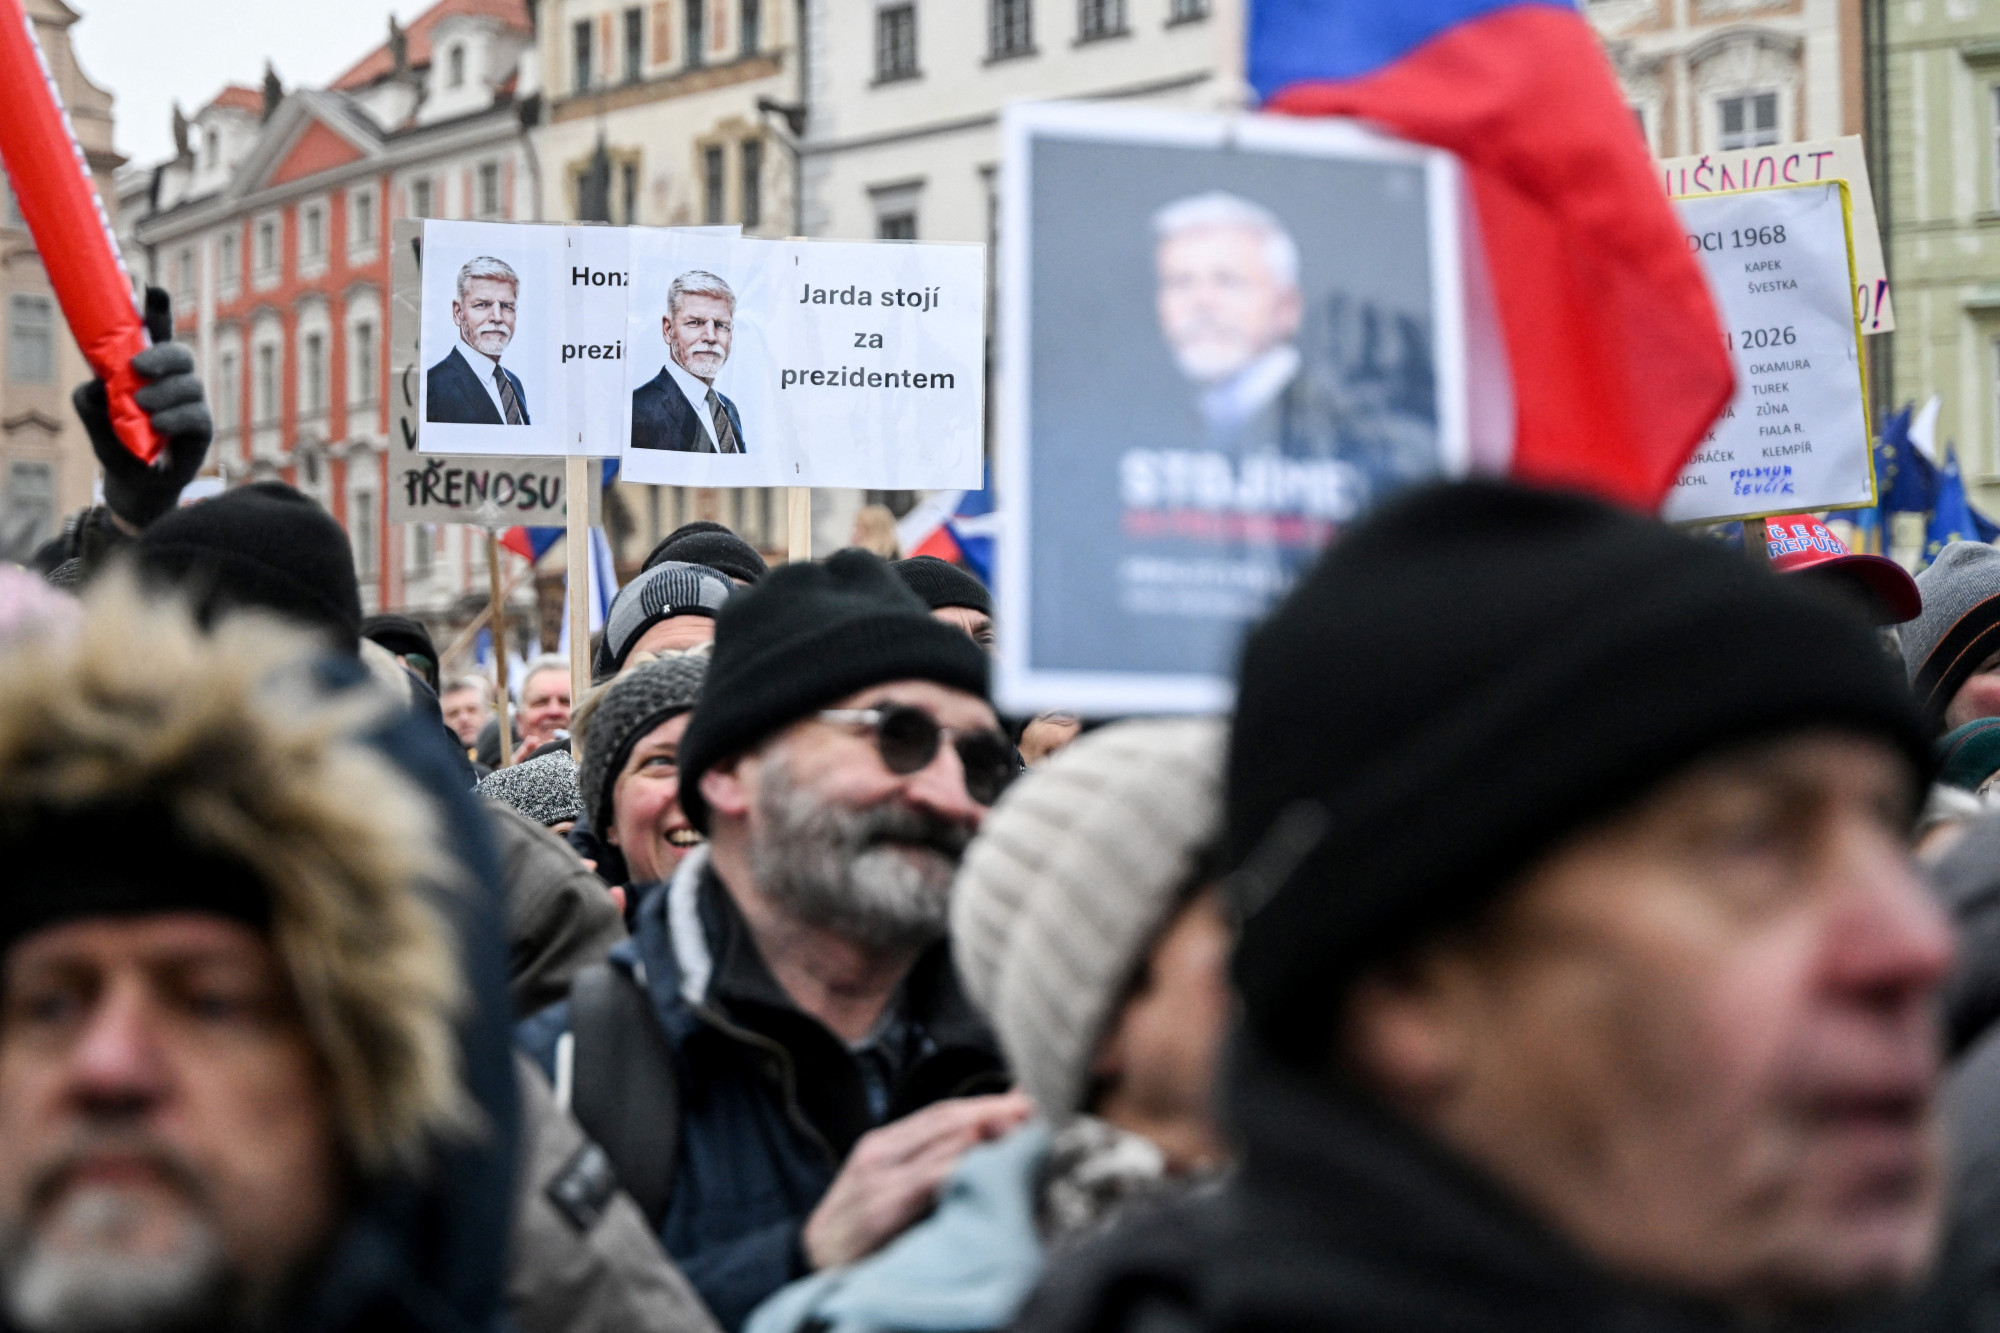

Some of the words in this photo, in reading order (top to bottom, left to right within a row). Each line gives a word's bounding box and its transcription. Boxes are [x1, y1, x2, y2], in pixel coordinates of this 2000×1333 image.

[1666, 150, 1834, 196] UŠNOST
[1686, 231, 1723, 253] DCI
[1731, 224, 1787, 249] 1968
[1745, 259, 1782, 273] KAPEK
[1748, 279, 1798, 294] ŠVESTKA
[800, 283, 872, 307] Jarda
[881, 286, 941, 312] stojí
[854, 331, 884, 350] za
[1741, 325, 1796, 349] 2026
[562, 339, 626, 364] prezi
[1750, 359, 1811, 375] OKAMURA
[781, 366, 955, 390] prezidentem
[1752, 382, 1790, 395] TUREK
[1756, 402, 1789, 416] ZŮNA
[1759, 424, 1791, 437] FIALA
[1794, 422, 1806, 434] R.
[1762, 441, 1813, 458] KLEMPÍŘ
[1672, 475, 1708, 488] AJCHL
[1733, 477, 1794, 495] ŠEVČÍK
[1767, 525, 1830, 540] ČES
[1767, 536, 1847, 560] REPUB
